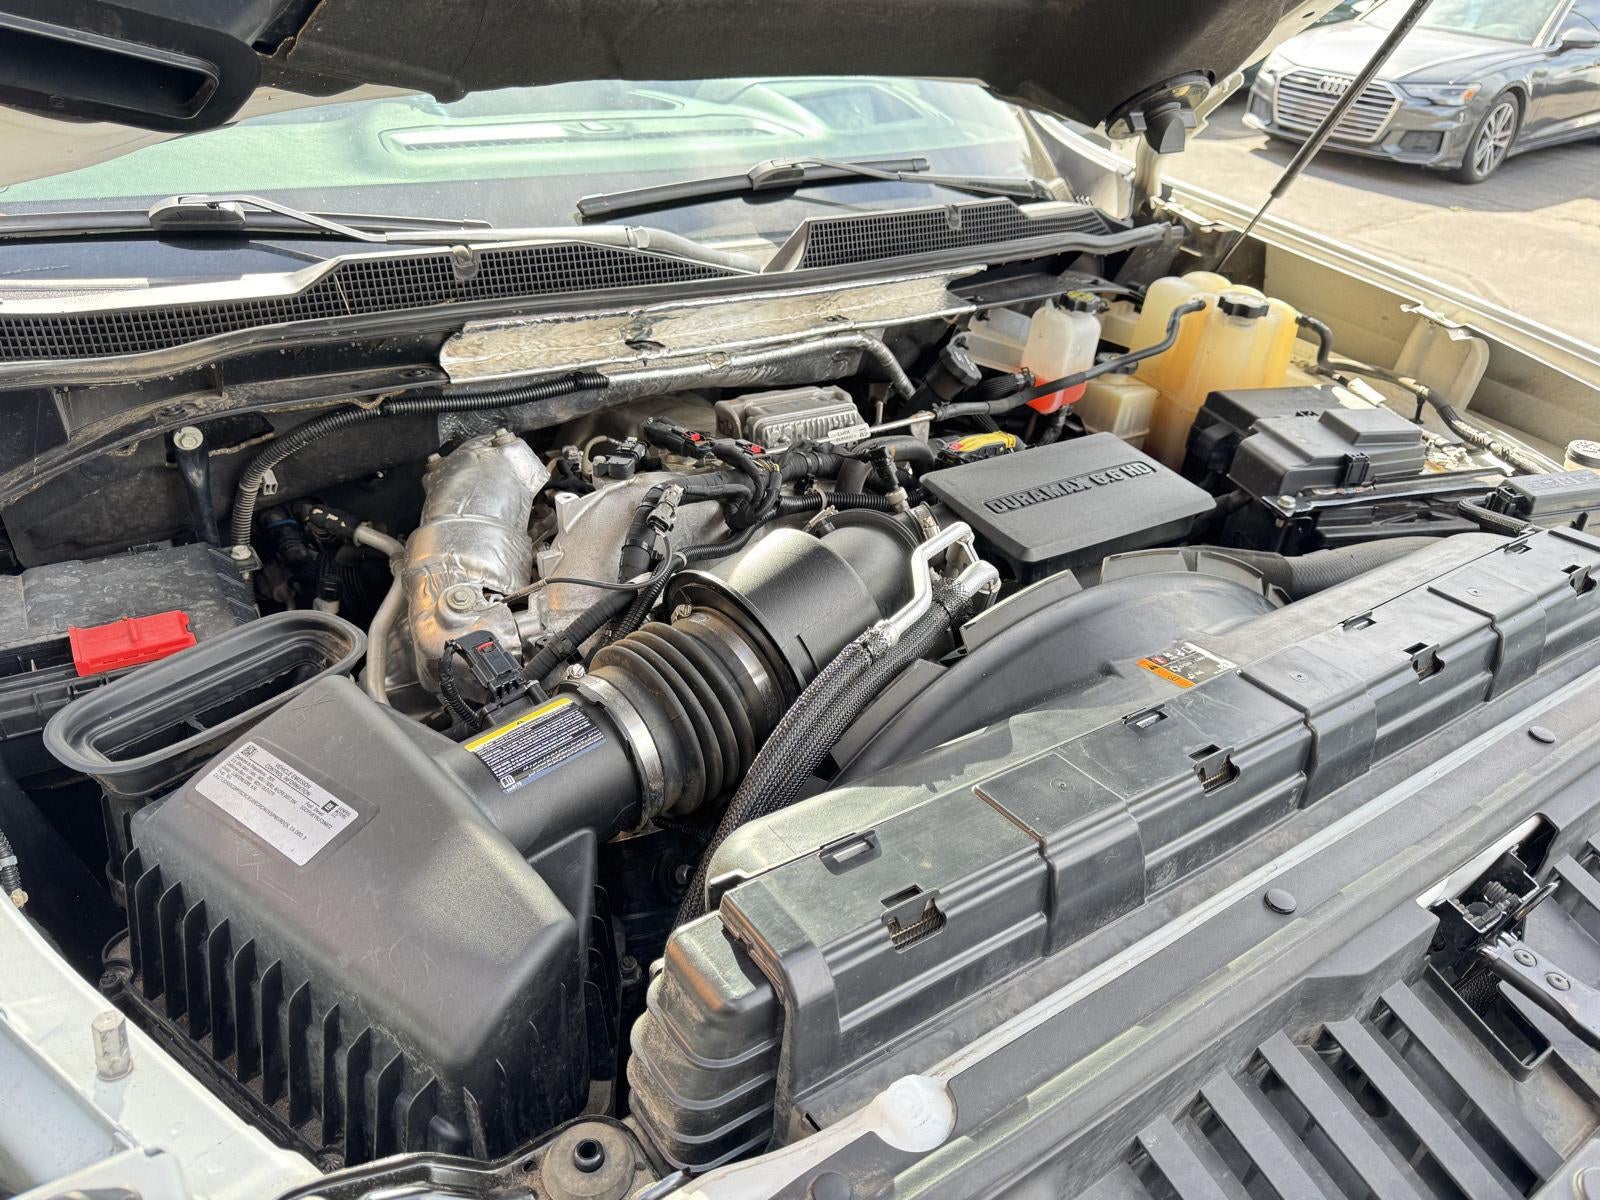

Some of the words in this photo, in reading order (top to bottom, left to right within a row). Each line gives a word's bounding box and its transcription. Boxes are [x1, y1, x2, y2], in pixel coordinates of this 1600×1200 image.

[985, 477, 1092, 513] DURAMAX
[1091, 470, 1125, 486] 6.6
[1124, 461, 1153, 477] HD
[264, 763, 284, 778] CONTROL
[282, 775, 311, 796] INFORMATION
[273, 762, 293, 776] VEHICLE
[290, 773, 312, 789] EMISSION
